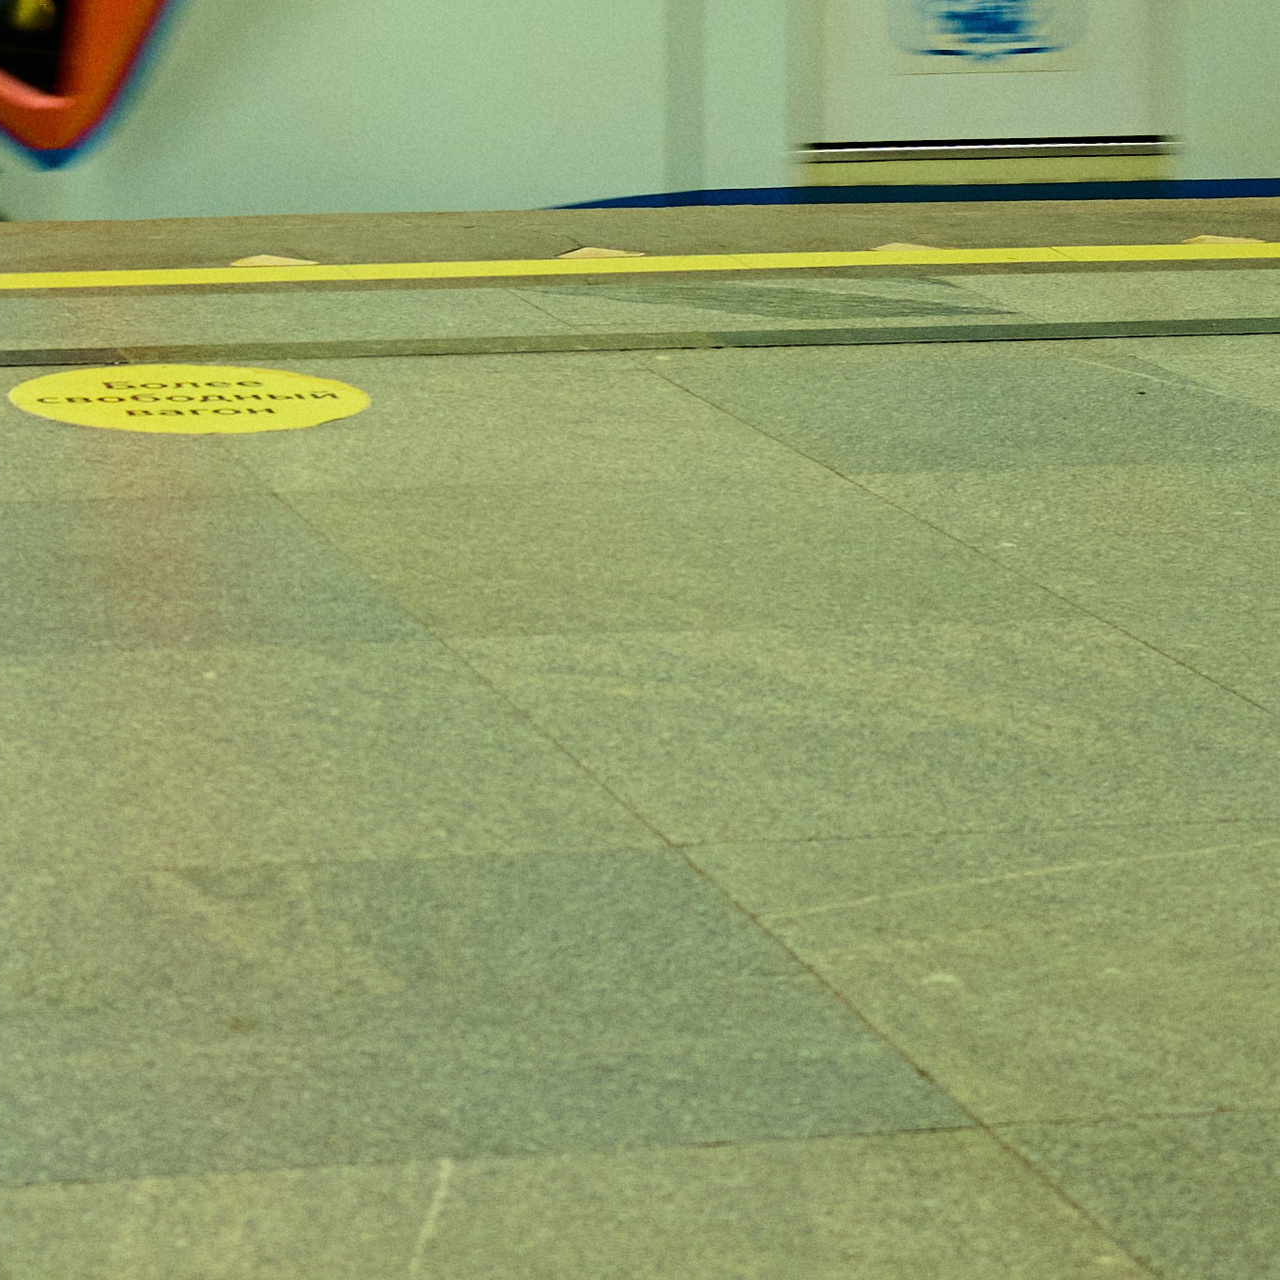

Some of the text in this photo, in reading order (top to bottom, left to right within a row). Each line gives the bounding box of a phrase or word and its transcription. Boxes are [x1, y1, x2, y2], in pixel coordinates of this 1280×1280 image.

[102, 380, 263, 390] Более
[37, 390, 339, 404] свободный
[126, 407, 276, 417] вагон
